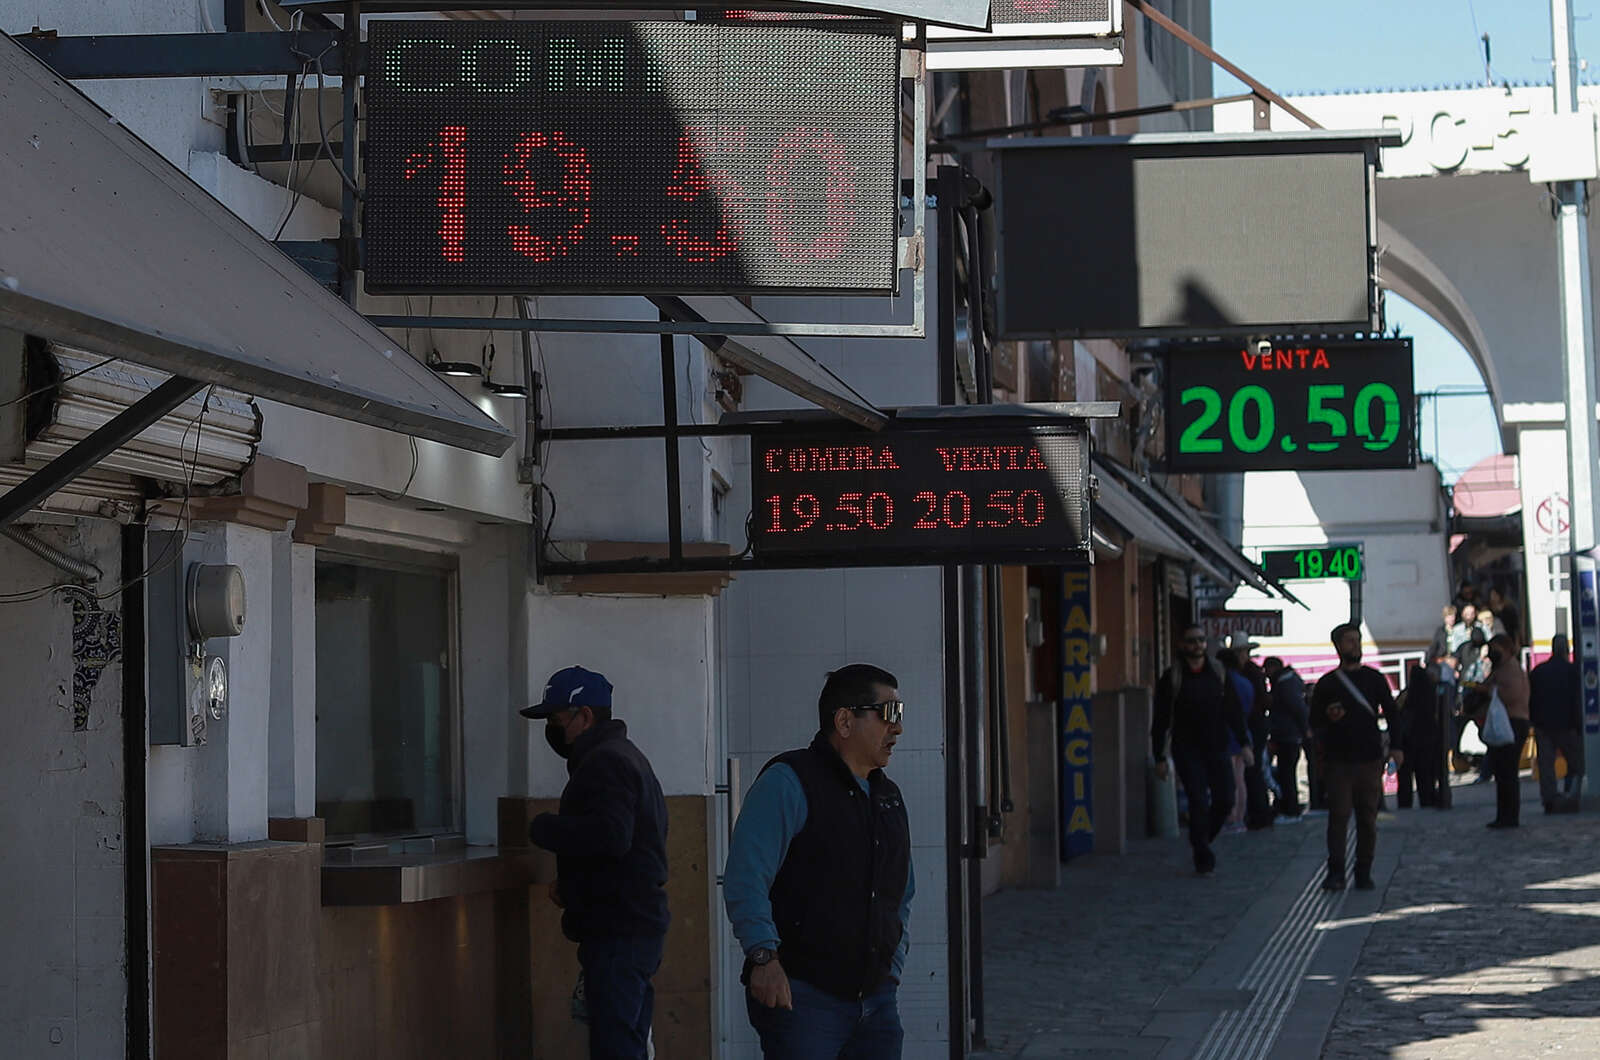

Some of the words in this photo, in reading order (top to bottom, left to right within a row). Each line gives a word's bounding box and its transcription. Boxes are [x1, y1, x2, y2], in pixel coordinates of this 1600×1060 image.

[404, 125, 856, 263] 19.50
[1241, 348, 1331, 371] VENTA
[1178, 382, 1401, 453] 20.50
[764, 446, 901, 473] COMPRA
[935, 446, 1047, 472] VENTA
[765, 491, 895, 533] 19.50
[911, 489, 1045, 529] 20.50
[1294, 548, 1360, 579] 19.40
[1063, 571, 1095, 834] FARMACIA
